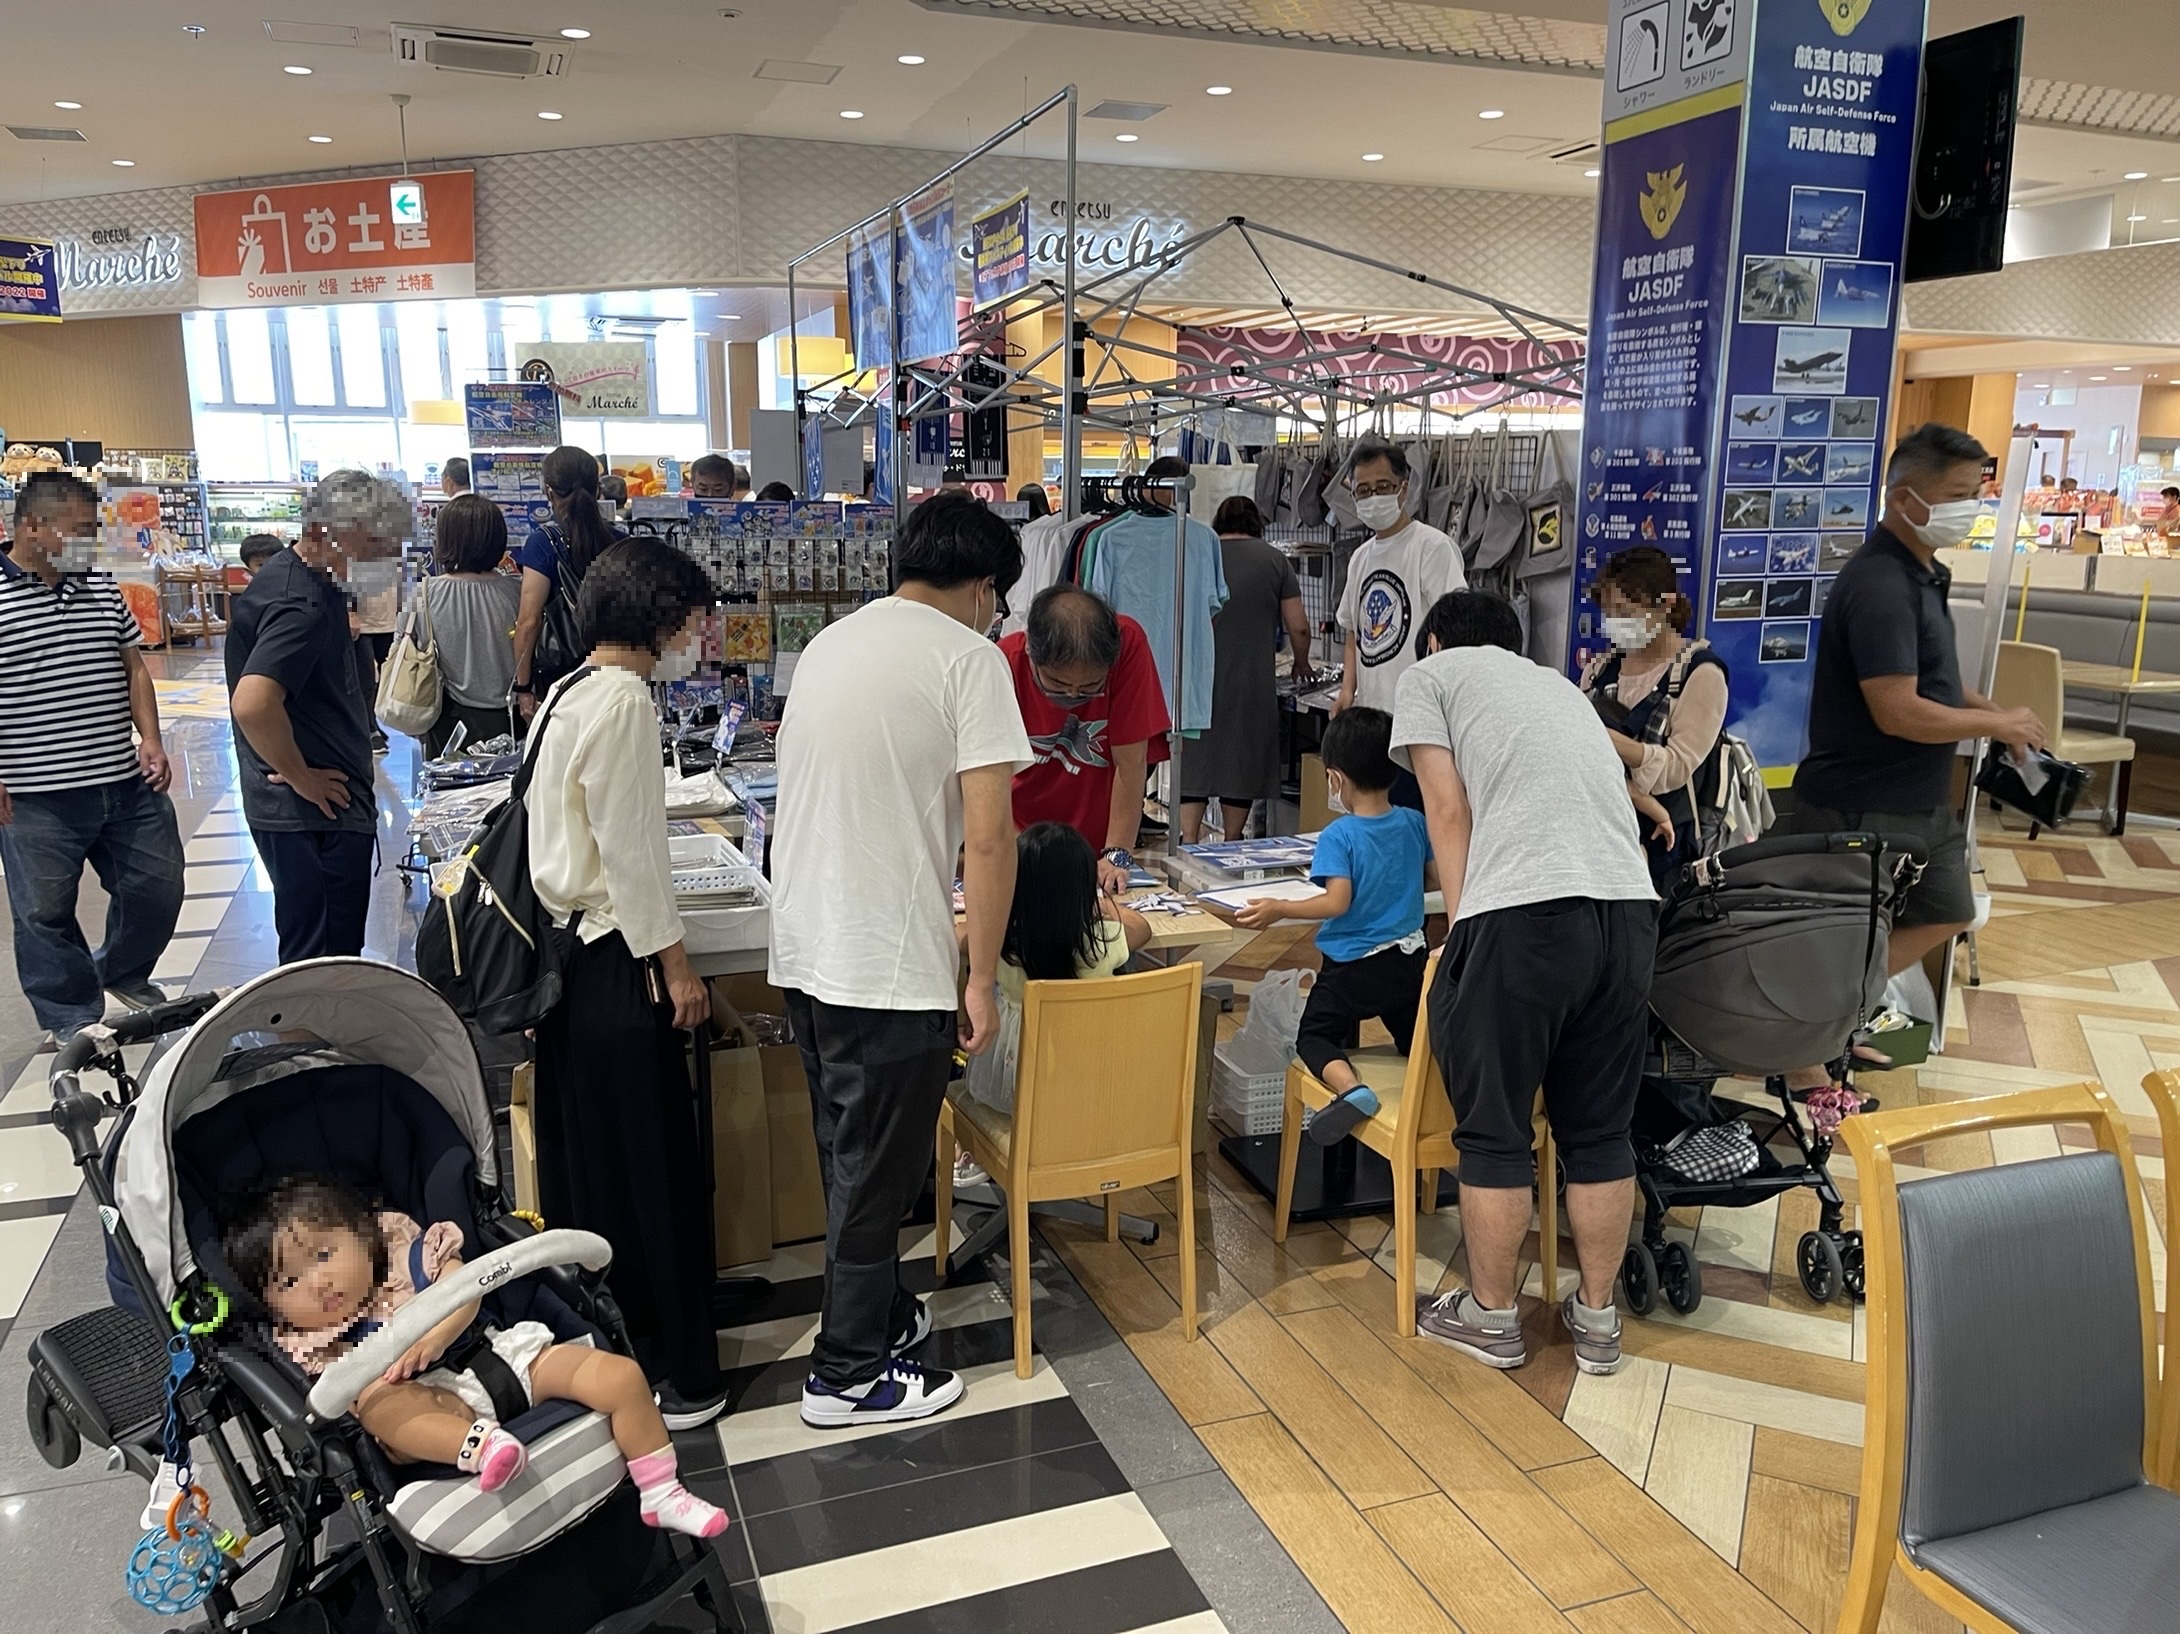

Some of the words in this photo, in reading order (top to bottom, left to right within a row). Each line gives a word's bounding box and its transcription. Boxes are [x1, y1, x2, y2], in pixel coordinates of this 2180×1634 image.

[1794, 44, 1884, 78] 航空自衛隊
[1684, 68, 1726, 90] ランドリー
[1803, 75, 1873, 103] JASDF
[1623, 91, 1656, 109] シャワー
[1770, 101, 1799, 113] Japan
[1800, 103, 1814, 114] Air
[1816, 104, 1873, 120] Self-Defense
[1874, 110, 1897, 123] Force
[1788, 126, 1877, 157] 所属航空機
[1622, 245, 1695, 280] 航空自衛隊
[248, 280, 307, 298] Souvenir
[318, 278, 339, 295] 선물
[350, 276, 387, 293] 土特产
[396, 273, 435, 291] 土特產
[1628, 275, 1684, 303] JASDF
[587, 395, 639, 409] Marché
